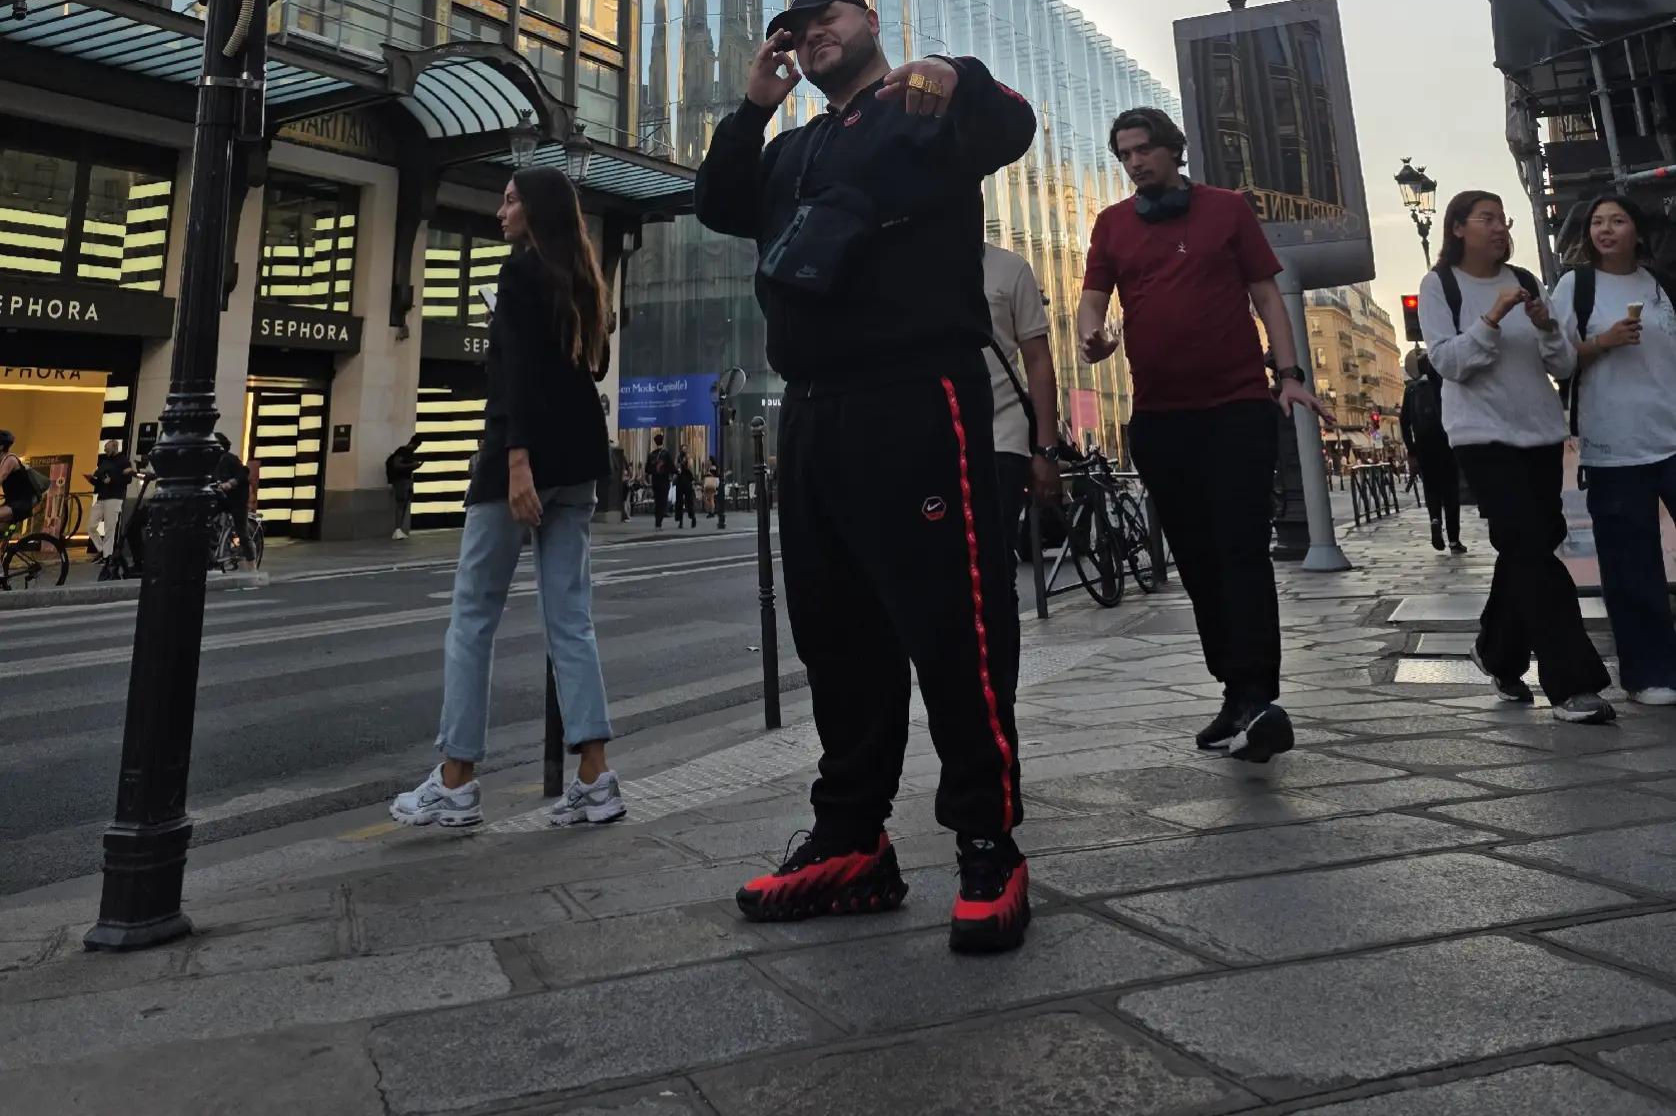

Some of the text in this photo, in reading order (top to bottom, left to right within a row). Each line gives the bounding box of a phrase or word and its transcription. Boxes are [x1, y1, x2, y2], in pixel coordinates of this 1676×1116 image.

[0, 295, 98, 321] PHORA
[261, 319, 348, 341] SEPHORA
[464, 337, 490, 354] SEP
